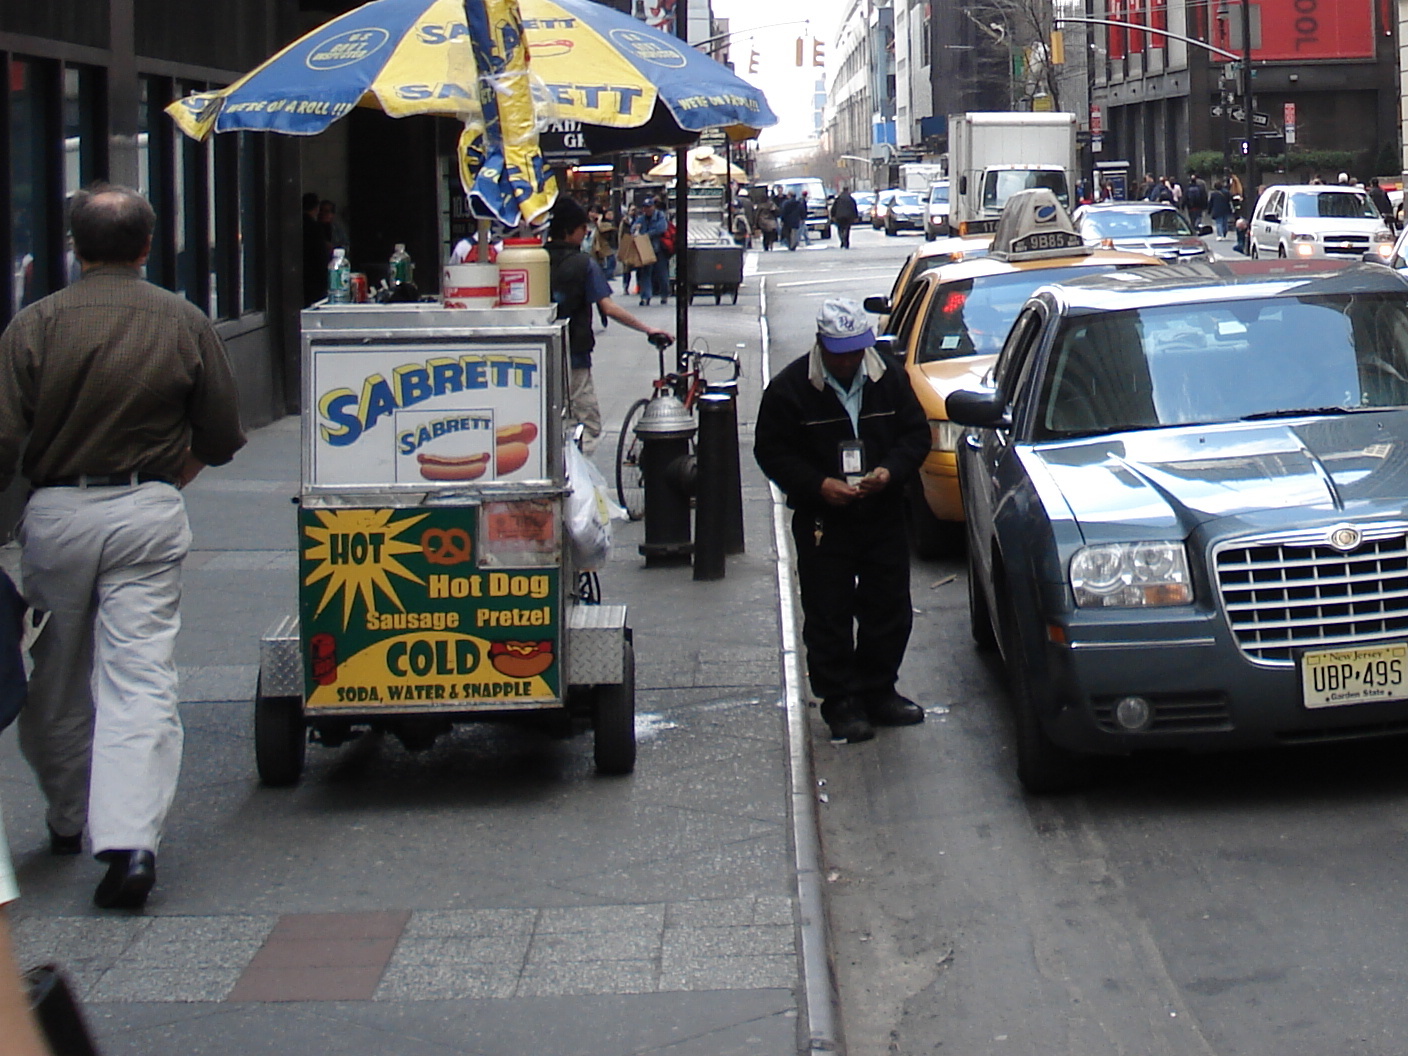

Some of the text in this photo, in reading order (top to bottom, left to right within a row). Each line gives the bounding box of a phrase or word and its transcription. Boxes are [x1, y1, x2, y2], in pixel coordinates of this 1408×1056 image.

[416, 18, 578, 45] SAETT
[394, 82, 643, 116] SAETT
[1030, 233, 1064, 250] 9B85
[319, 355, 538, 447] SABRETT
[398, 415, 492, 456] SABRETT
[330, 532, 385, 566] HOT
[429, 572, 550, 599] Hot Dog
[366, 606, 551, 630] Sausage Pretzel
[386, 639, 481, 677] COLD
[1329, 650, 1384, 663] New Jersey
[337, 681, 532, 704] SODA, WATER & SNAPPLE
[1331, 689, 1385, 701] Garden State
